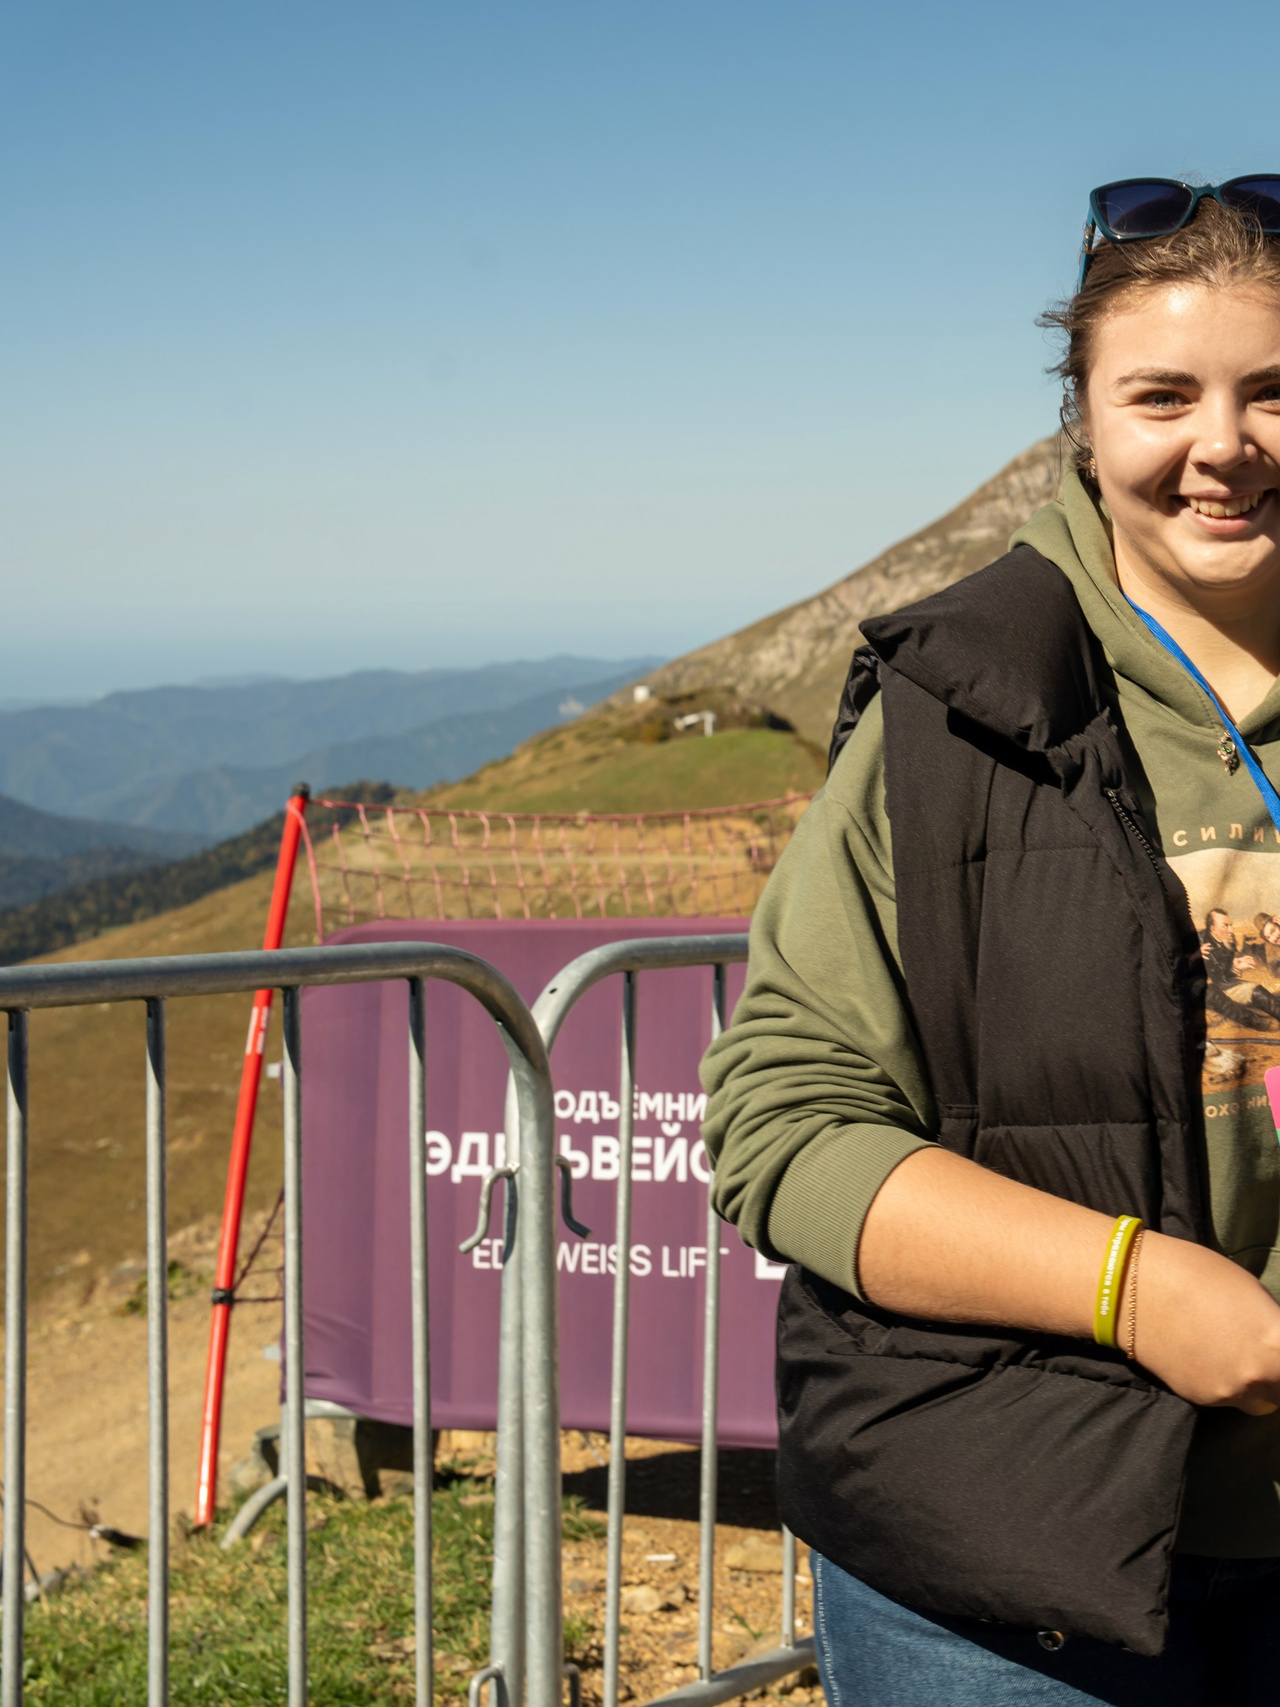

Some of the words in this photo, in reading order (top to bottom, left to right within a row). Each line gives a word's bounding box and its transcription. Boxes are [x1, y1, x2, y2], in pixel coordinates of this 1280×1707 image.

[553, 1084, 709, 1124] ОДЪМНИ
[1204, 1094, 1272, 1119] ОХОНИ
[425, 1121, 712, 1184] ЭДЬВЕЙС
[473, 1238, 652, 1277] EDWEIS
[662, 1245, 730, 1278] LIF
